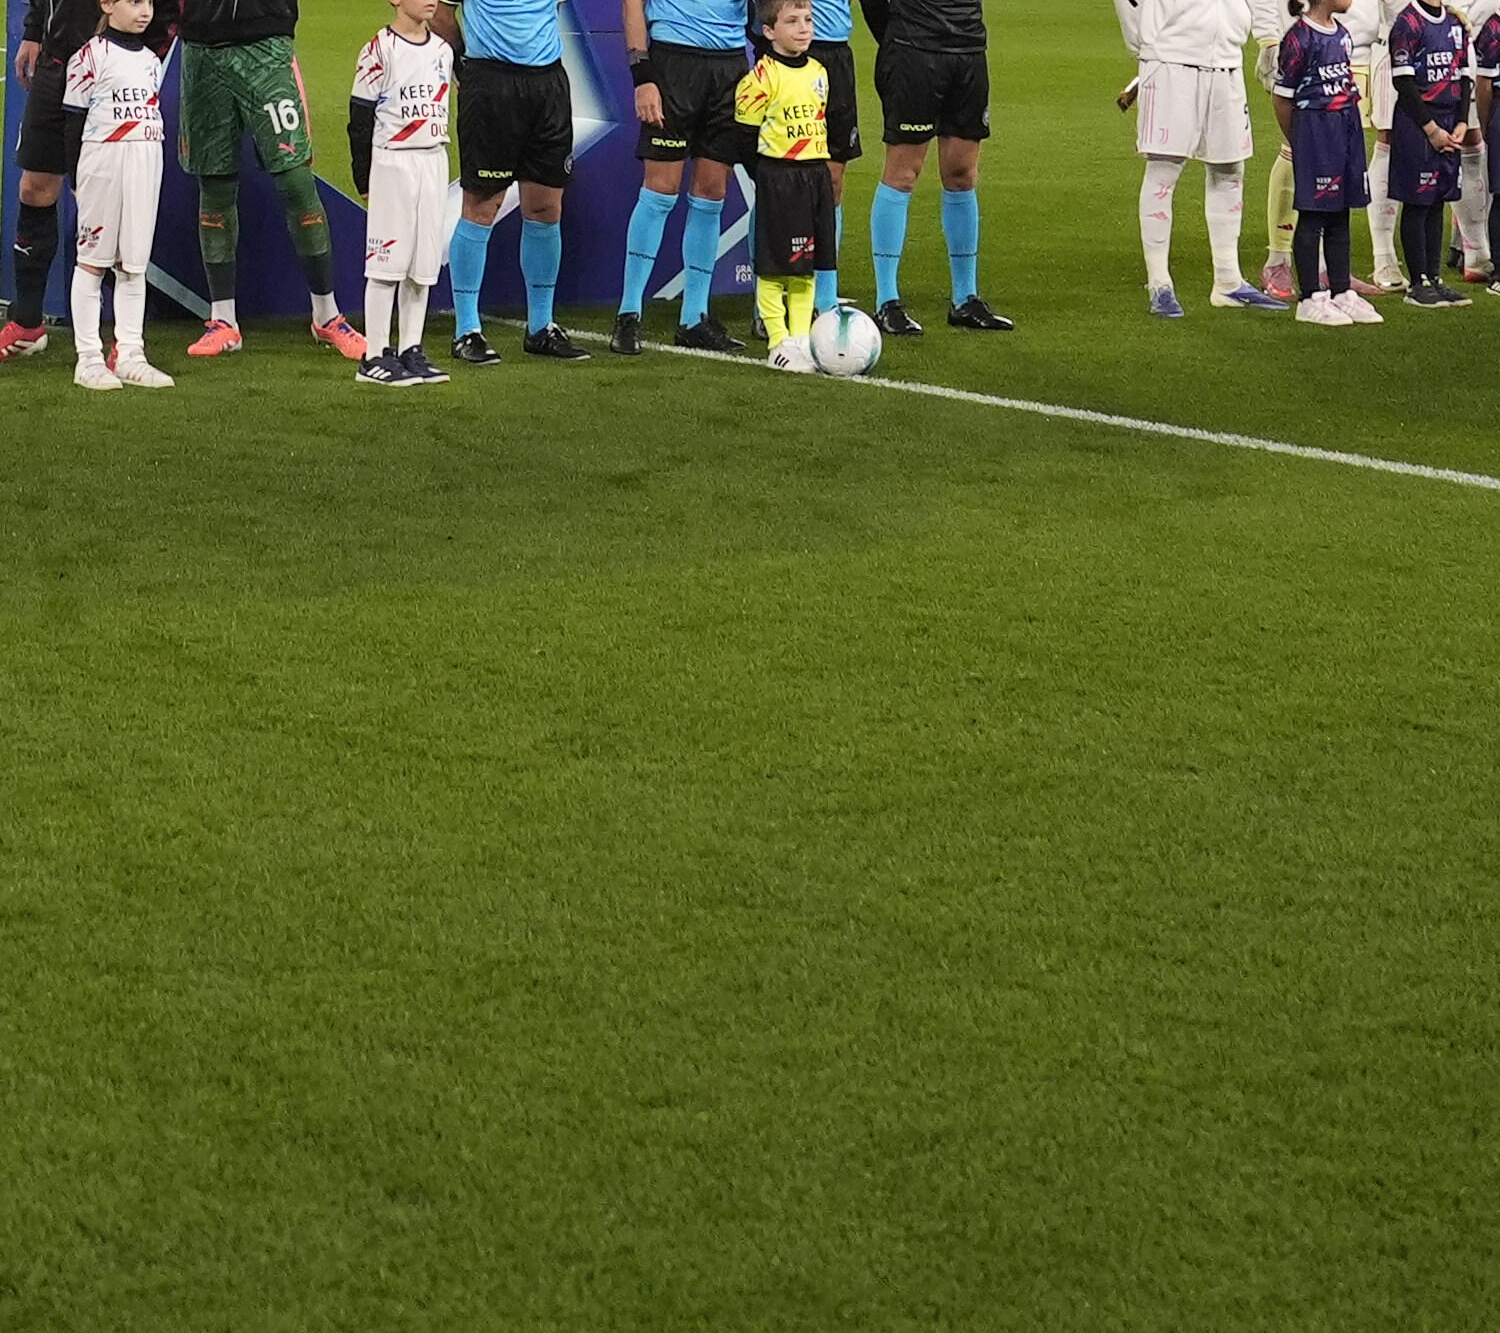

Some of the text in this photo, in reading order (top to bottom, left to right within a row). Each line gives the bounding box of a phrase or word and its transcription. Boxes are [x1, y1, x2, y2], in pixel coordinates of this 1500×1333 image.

[1426, 51, 1454, 67] KEEP
[1318, 62, 1350, 80] KEEP
[111, 88, 149, 104] KEEP
[399, 84, 434, 102] KEEP
[263, 98, 300, 135] 16
[783, 103, 816, 120] KEEP
[899, 123, 934, 132] GIVOVA
[651, 137, 687, 148] GIVOVA
[477, 169, 513, 179] GIVOVA
